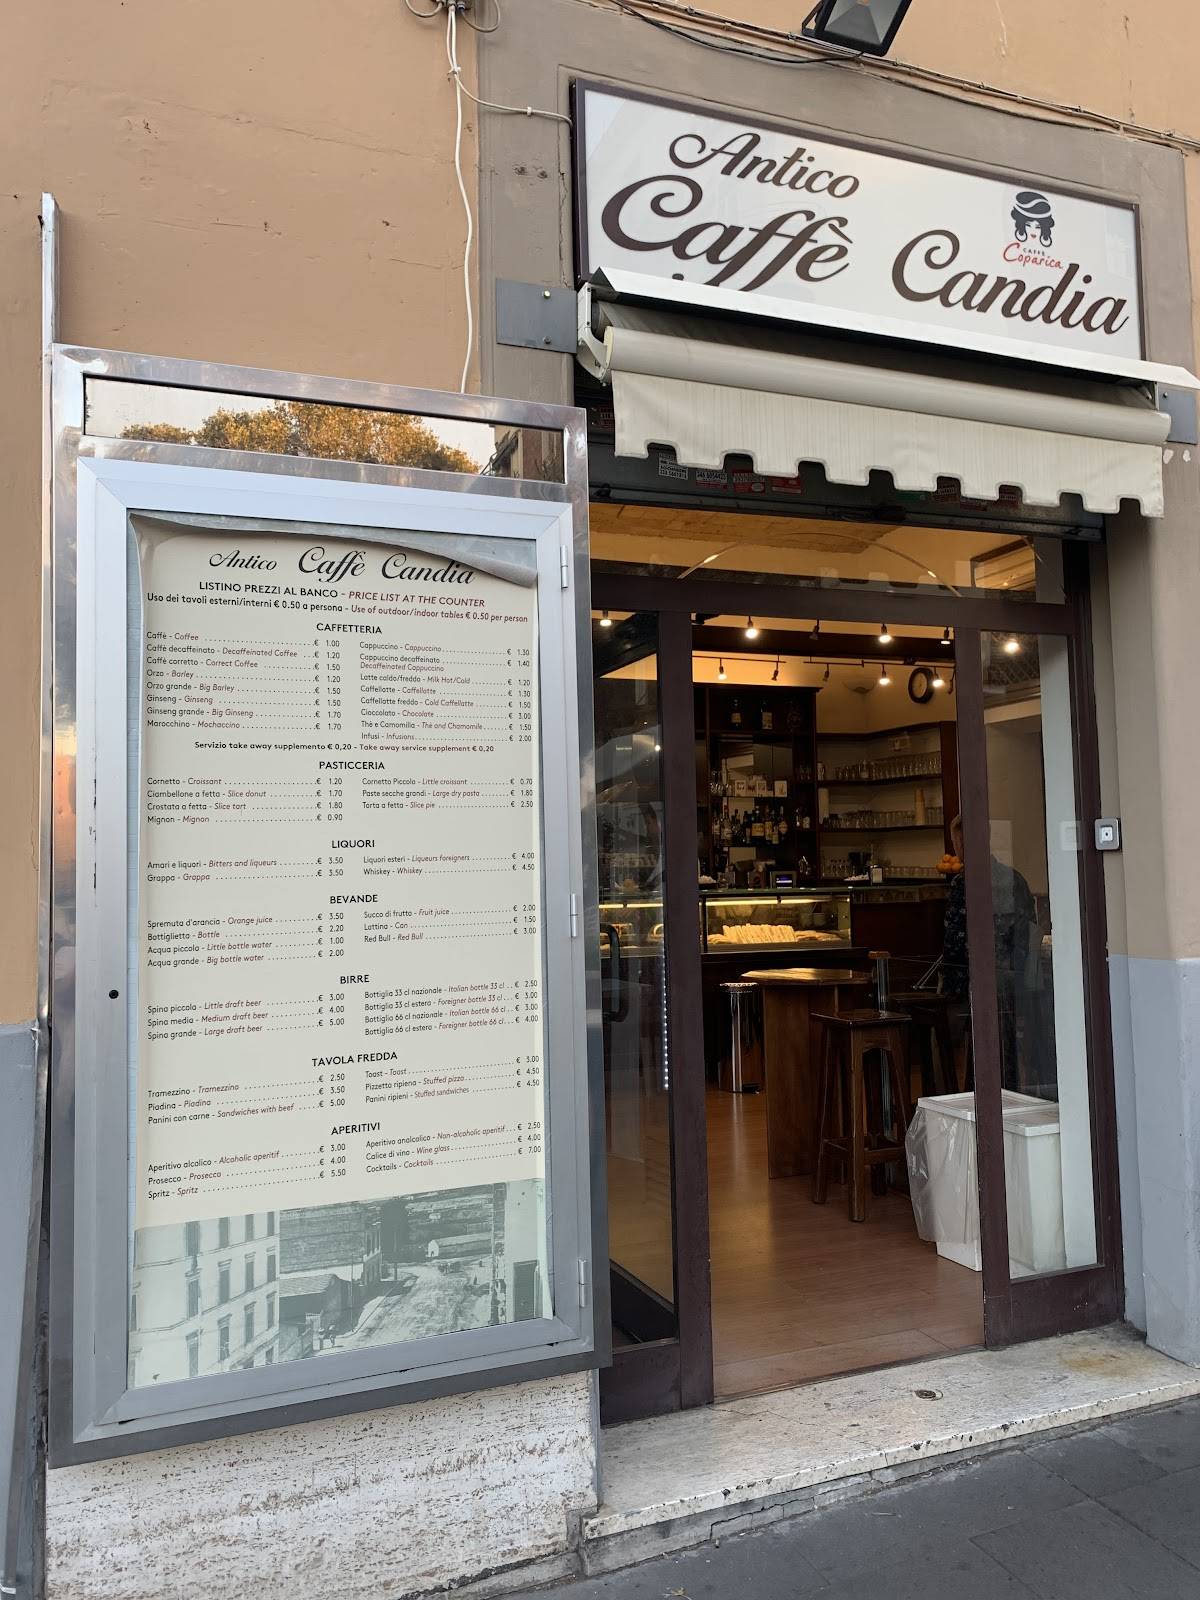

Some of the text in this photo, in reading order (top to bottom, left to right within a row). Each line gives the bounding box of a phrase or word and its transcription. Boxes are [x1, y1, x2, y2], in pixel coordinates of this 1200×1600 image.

[669, 132, 860, 199] Antico
[601, 174, 1129, 335] Caffè Candia
[1003, 242, 1063, 269] Coparica
[209, 546, 476, 585] Antico Caffè Candia
[199, 582, 485, 607] LISTINO PREZZI AL BANCO PRICE LIST AT THE COUNTER
[147, 593, 164, 602] Uso
[166, 594, 179, 603] dei
[182, 595, 207, 604] tavoli
[209, 597, 272, 608] esterni/interni
[274, 599, 280, 608] €
[282, 600, 300, 609] 0.50
[310, 603, 343, 612] persona
[351, 605, 366, 613] Use
[367, 606, 376, 614] of
[378, 608, 438, 618] outdoor/indoor
[440, 609, 464, 619] tables
[472, 612, 489, 621] 0.50
[490, 614, 503, 623] per
[504, 615, 528, 623] person
[316, 623, 382, 634] CAFFETTERIA
[146, 632, 199, 641] Caffè Coffee
[146, 644, 167, 652] Caffè
[169, 645, 215, 654] decaffeinato
[222, 648, 273, 656] Decaffeinated
[359, 641, 442, 652] Cappuccino Cappuccino
[171, 670, 194, 679] Barley
[146, 682, 235, 693] Orzo grande Big Barley
[146, 695, 213, 705] Ginseng Ginseng
[147, 720, 240, 729] Marocchino Mochaccino
[250, 743, 272, 751] away
[274, 743, 326, 751] supplemento
[380, 745, 400, 753] away
[429, 745, 471, 753] supplement
[319, 761, 385, 770] PASTICCERIA
[147, 790, 266, 798] Ciambellone fetta Slice donut
[148, 816, 175, 825] Mignon
[182, 816, 209, 825] Mignon
[331, 839, 375, 849] LIQUORI
[178, 861, 201, 870] liquori
[208, 860, 232, 868] Bitters
[234, 860, 248, 868] and
[250, 859, 277, 869] liqueurs
[363, 867, 422, 876] Whiskey Whiskey
[147, 873, 210, 883] Grappa Grappa
[329, 894, 378, 904] BEVANDE
[147, 916, 273, 929] Spremuta d'arancia Orange juice
[147, 932, 190, 942] Bottiglietta
[197, 931, 220, 939] Bottle
[364, 935, 377, 943] Red
[378, 934, 390, 942] Bull
[147, 946, 172, 955] Acqua
[173, 944, 199, 953] piccola
[207, 943, 225, 951] Little
[227, 942, 249, 950] bottle
[340, 974, 370, 984] BIRRE
[147, 1006, 168, 1015] Spina
[170, 1004, 197, 1014] piccola
[204, 1002, 223, 1010] Little
[225, 1001, 244, 1009] draft
[312, 1051, 397, 1067] TAVOLA FREDDA
[365, 1068, 407, 1078] Toast Toast
[148, 1084, 239, 1098] Tramezzino Tramezzino
[365, 1087, 469, 1103] Panini ripieni Stuffed sandwiches
[148, 1099, 211, 1111] Piadina Piadina
[148, 1102, 295, 1124] Panini con carne Sandwiches with beef
[331, 1122, 380, 1135] APERITIVI
[148, 1162, 182, 1173] Aperitivo
[183, 1158, 211, 1168] alcolico
[219, 1154, 251, 1165] Alcoholic
[253, 1150, 280, 1161] aperitif
[366, 1159, 433, 1173] Cocktails Cocktails
[148, 1156, 346, 1186] Prosecco Prosecco 4.00
[148, 1169, 346, 1200] Spritz Spritz 5.50
